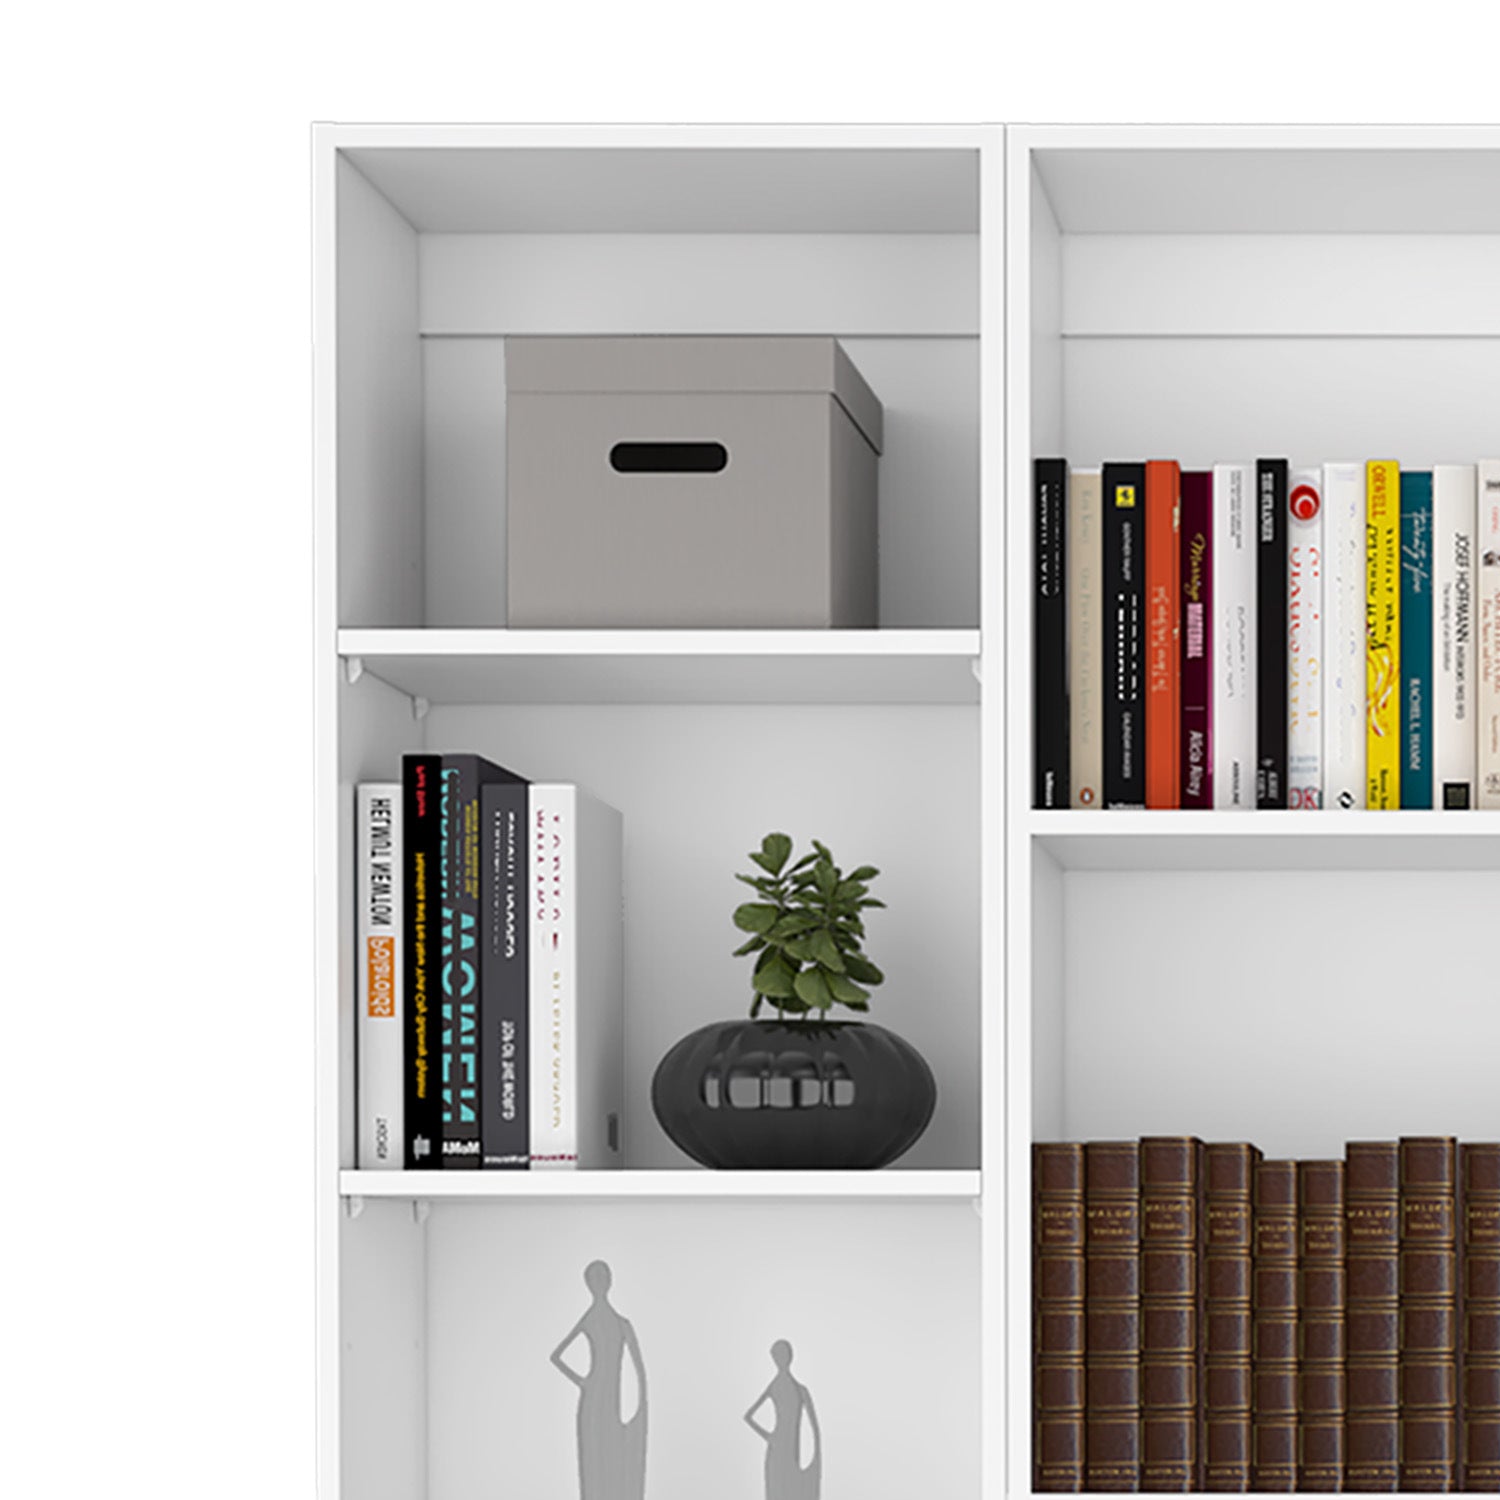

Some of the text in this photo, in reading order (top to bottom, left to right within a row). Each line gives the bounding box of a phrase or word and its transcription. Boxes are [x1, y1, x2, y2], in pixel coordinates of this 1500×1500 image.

[1372, 465, 1387, 518] ORWELL
[1455, 532, 1469, 568] JOSEF
[1455, 571, 1469, 642] HOFFMANN
